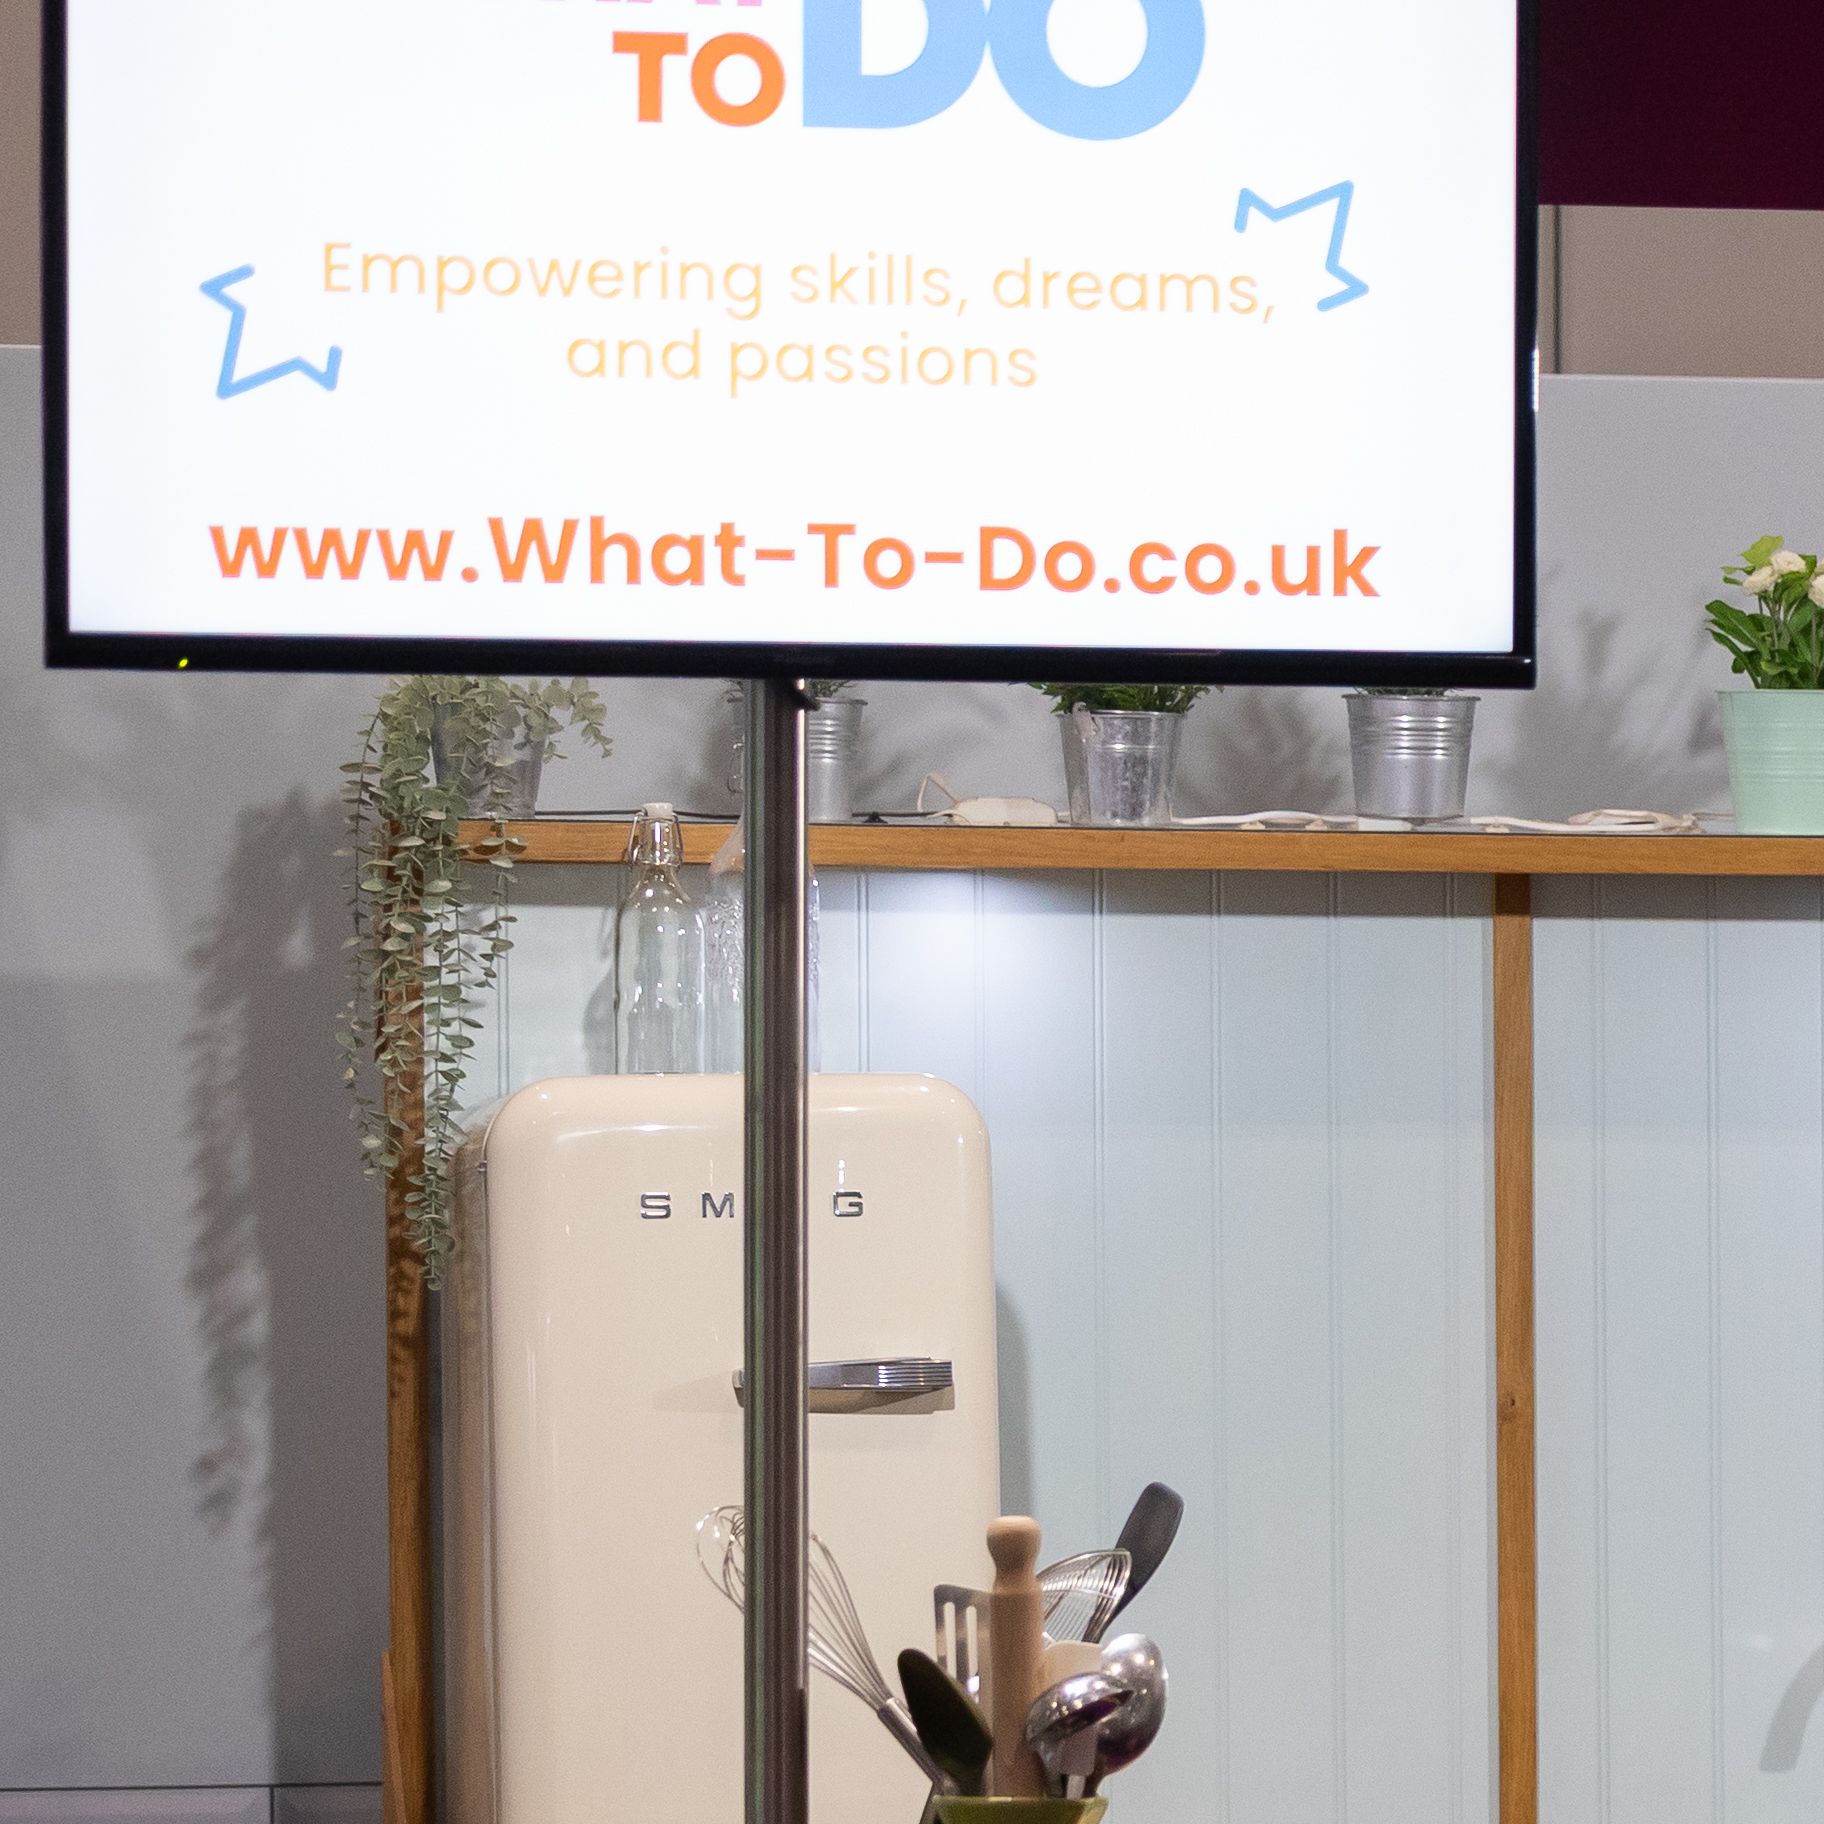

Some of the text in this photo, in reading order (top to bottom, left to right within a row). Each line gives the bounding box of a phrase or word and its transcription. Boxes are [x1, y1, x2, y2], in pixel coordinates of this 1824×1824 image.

[611, 31, 786, 127] TO
[803, 0, 1206, 140] DO
[322, 242, 1275, 324] Empowering skills, dreams,
[566, 329, 1039, 399] and passions
[208, 515, 1382, 599] www.What-To-Do.co.uk
[640, 1191, 864, 1220] SMG
